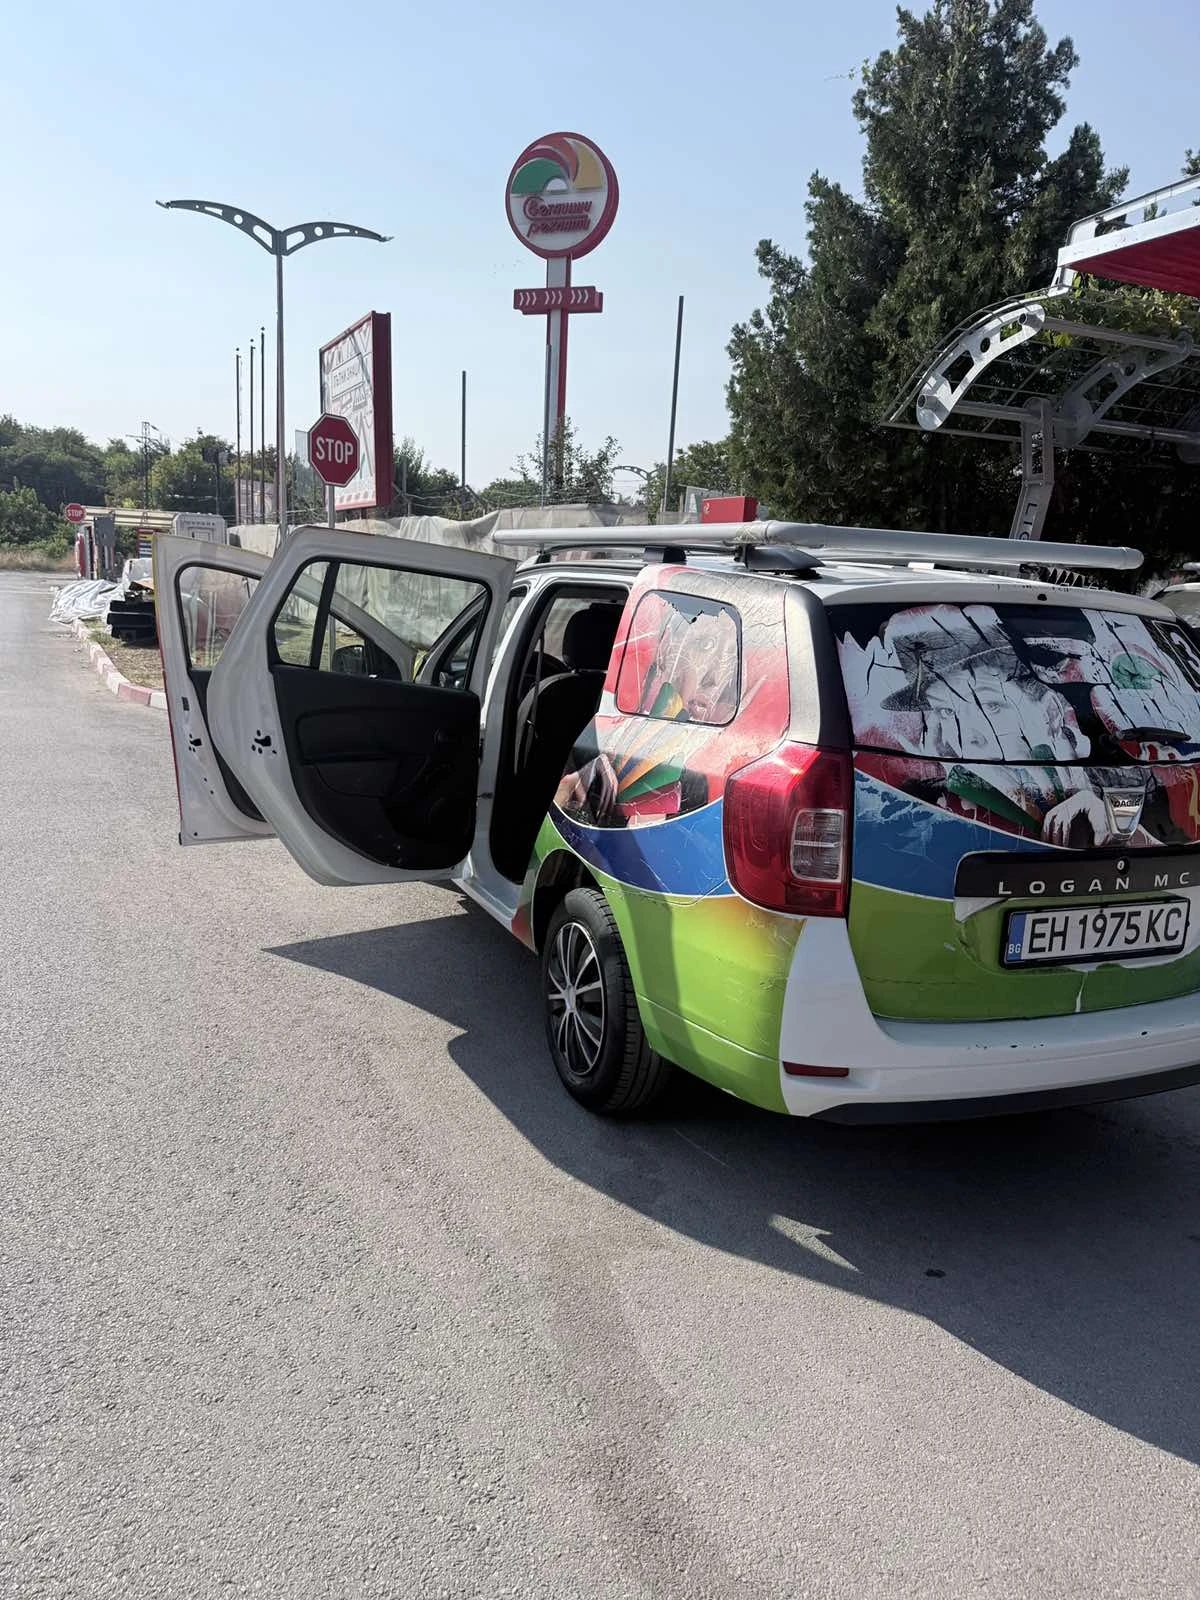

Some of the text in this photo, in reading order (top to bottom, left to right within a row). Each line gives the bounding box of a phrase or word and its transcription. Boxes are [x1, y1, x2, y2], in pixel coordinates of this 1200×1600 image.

[315, 436, 354, 465] STOP
[67, 508, 83, 518] STOP
[998, 871, 1191, 895] LOGAN MC
[1028, 907, 1182, 954] EH 1975 KC
[1008, 943, 1022, 955] BG
